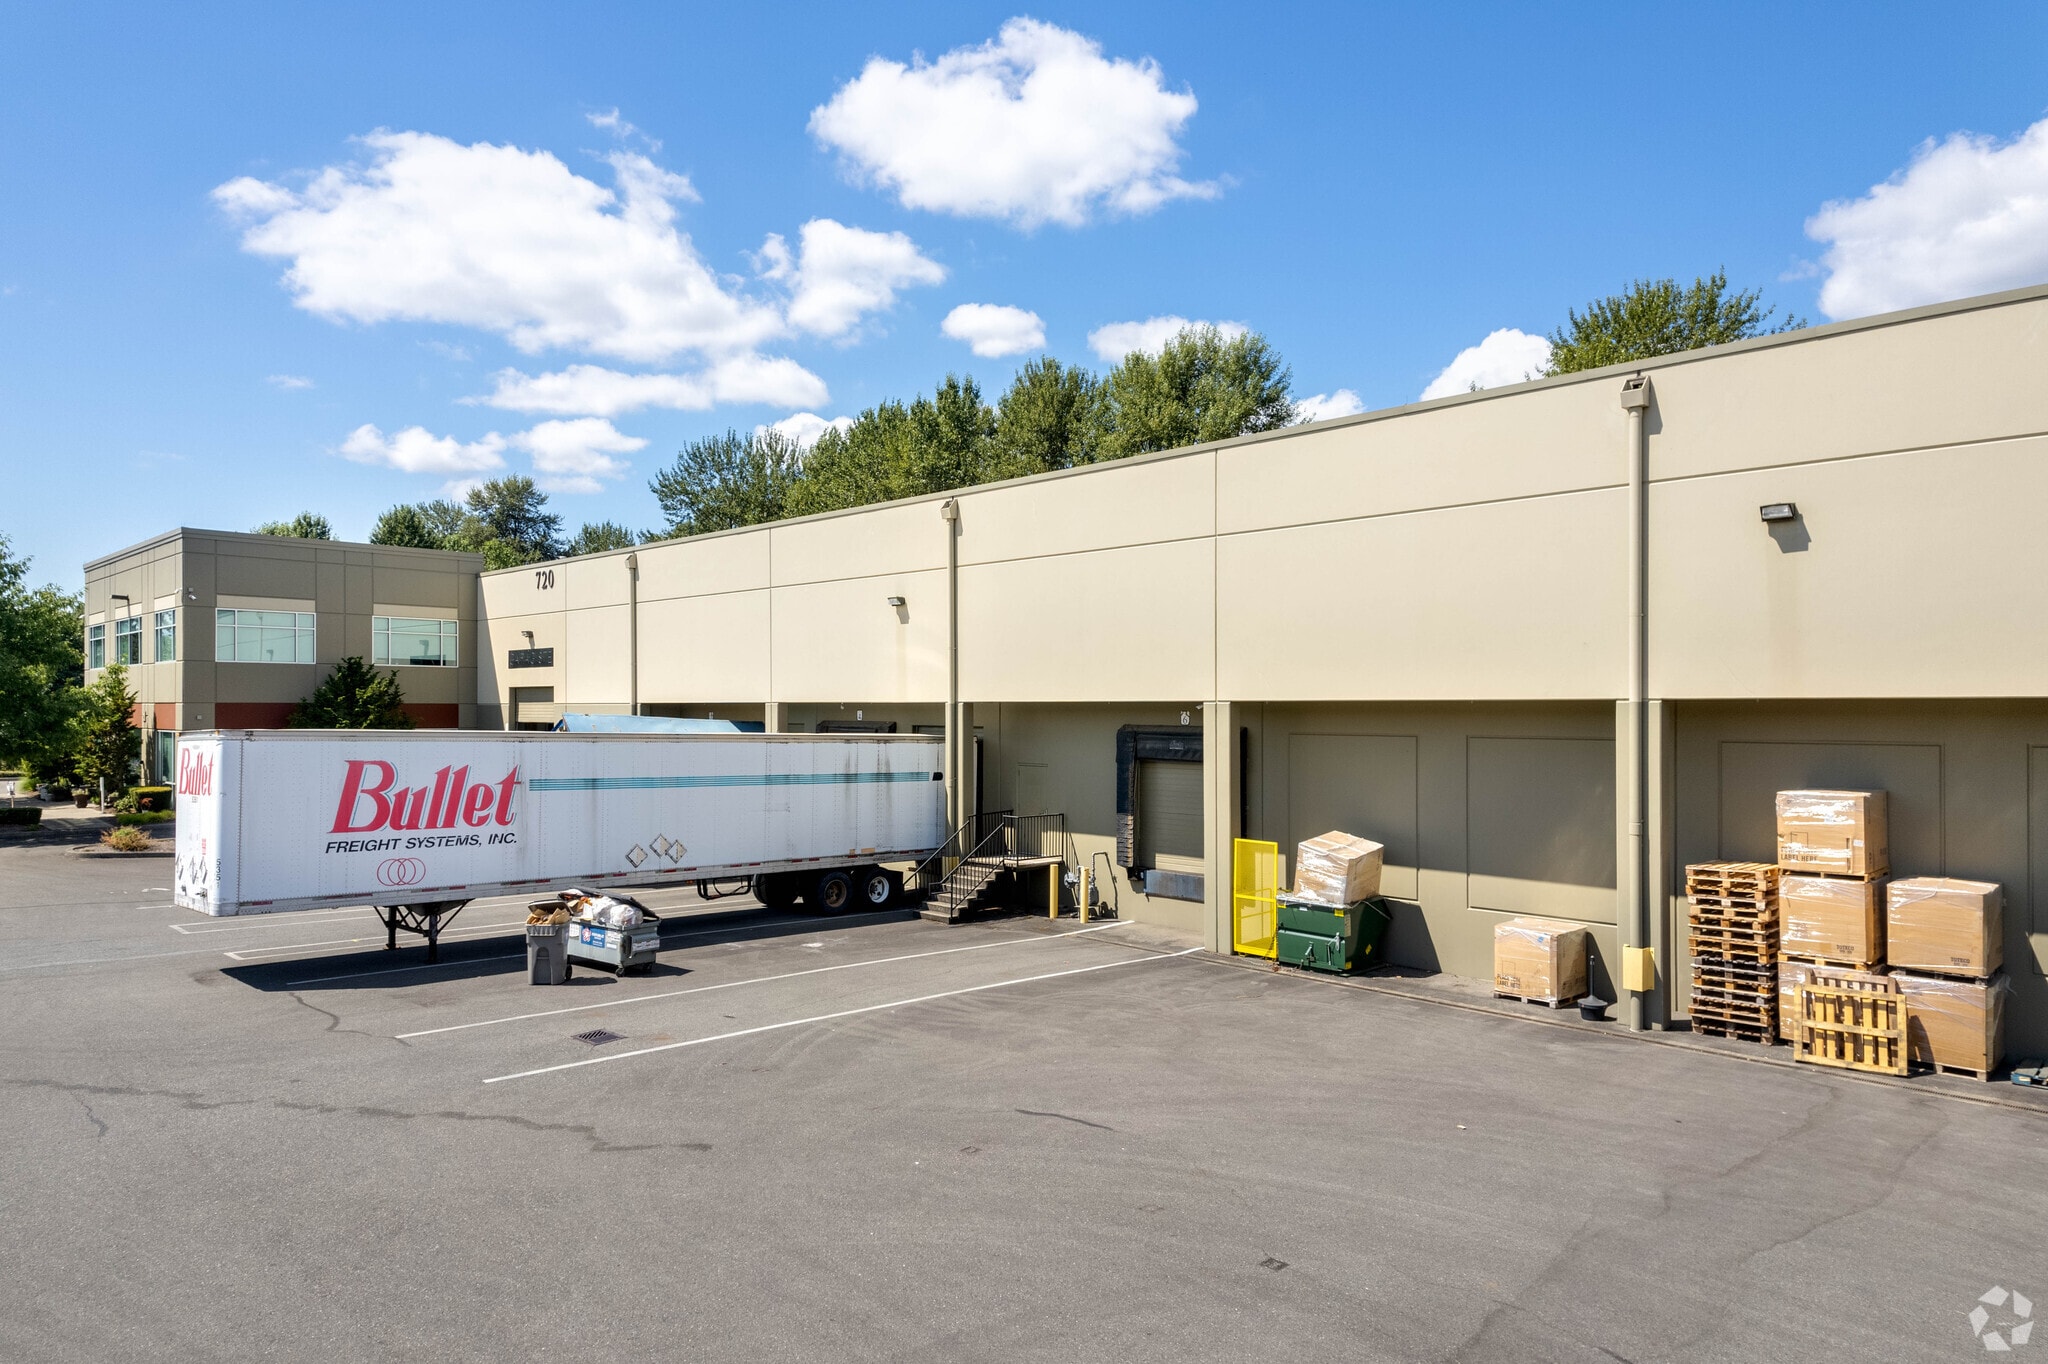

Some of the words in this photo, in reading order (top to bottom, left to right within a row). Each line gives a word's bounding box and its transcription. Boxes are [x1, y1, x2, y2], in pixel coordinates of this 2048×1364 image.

[535, 569, 555, 590] 720
[178, 747, 214, 796] Bullet
[327, 760, 521, 833] Bullet
[325, 838, 401, 853] FREIGHT
[405, 834, 482, 849] SYSTEMS,
[488, 833, 517, 845] INC.
